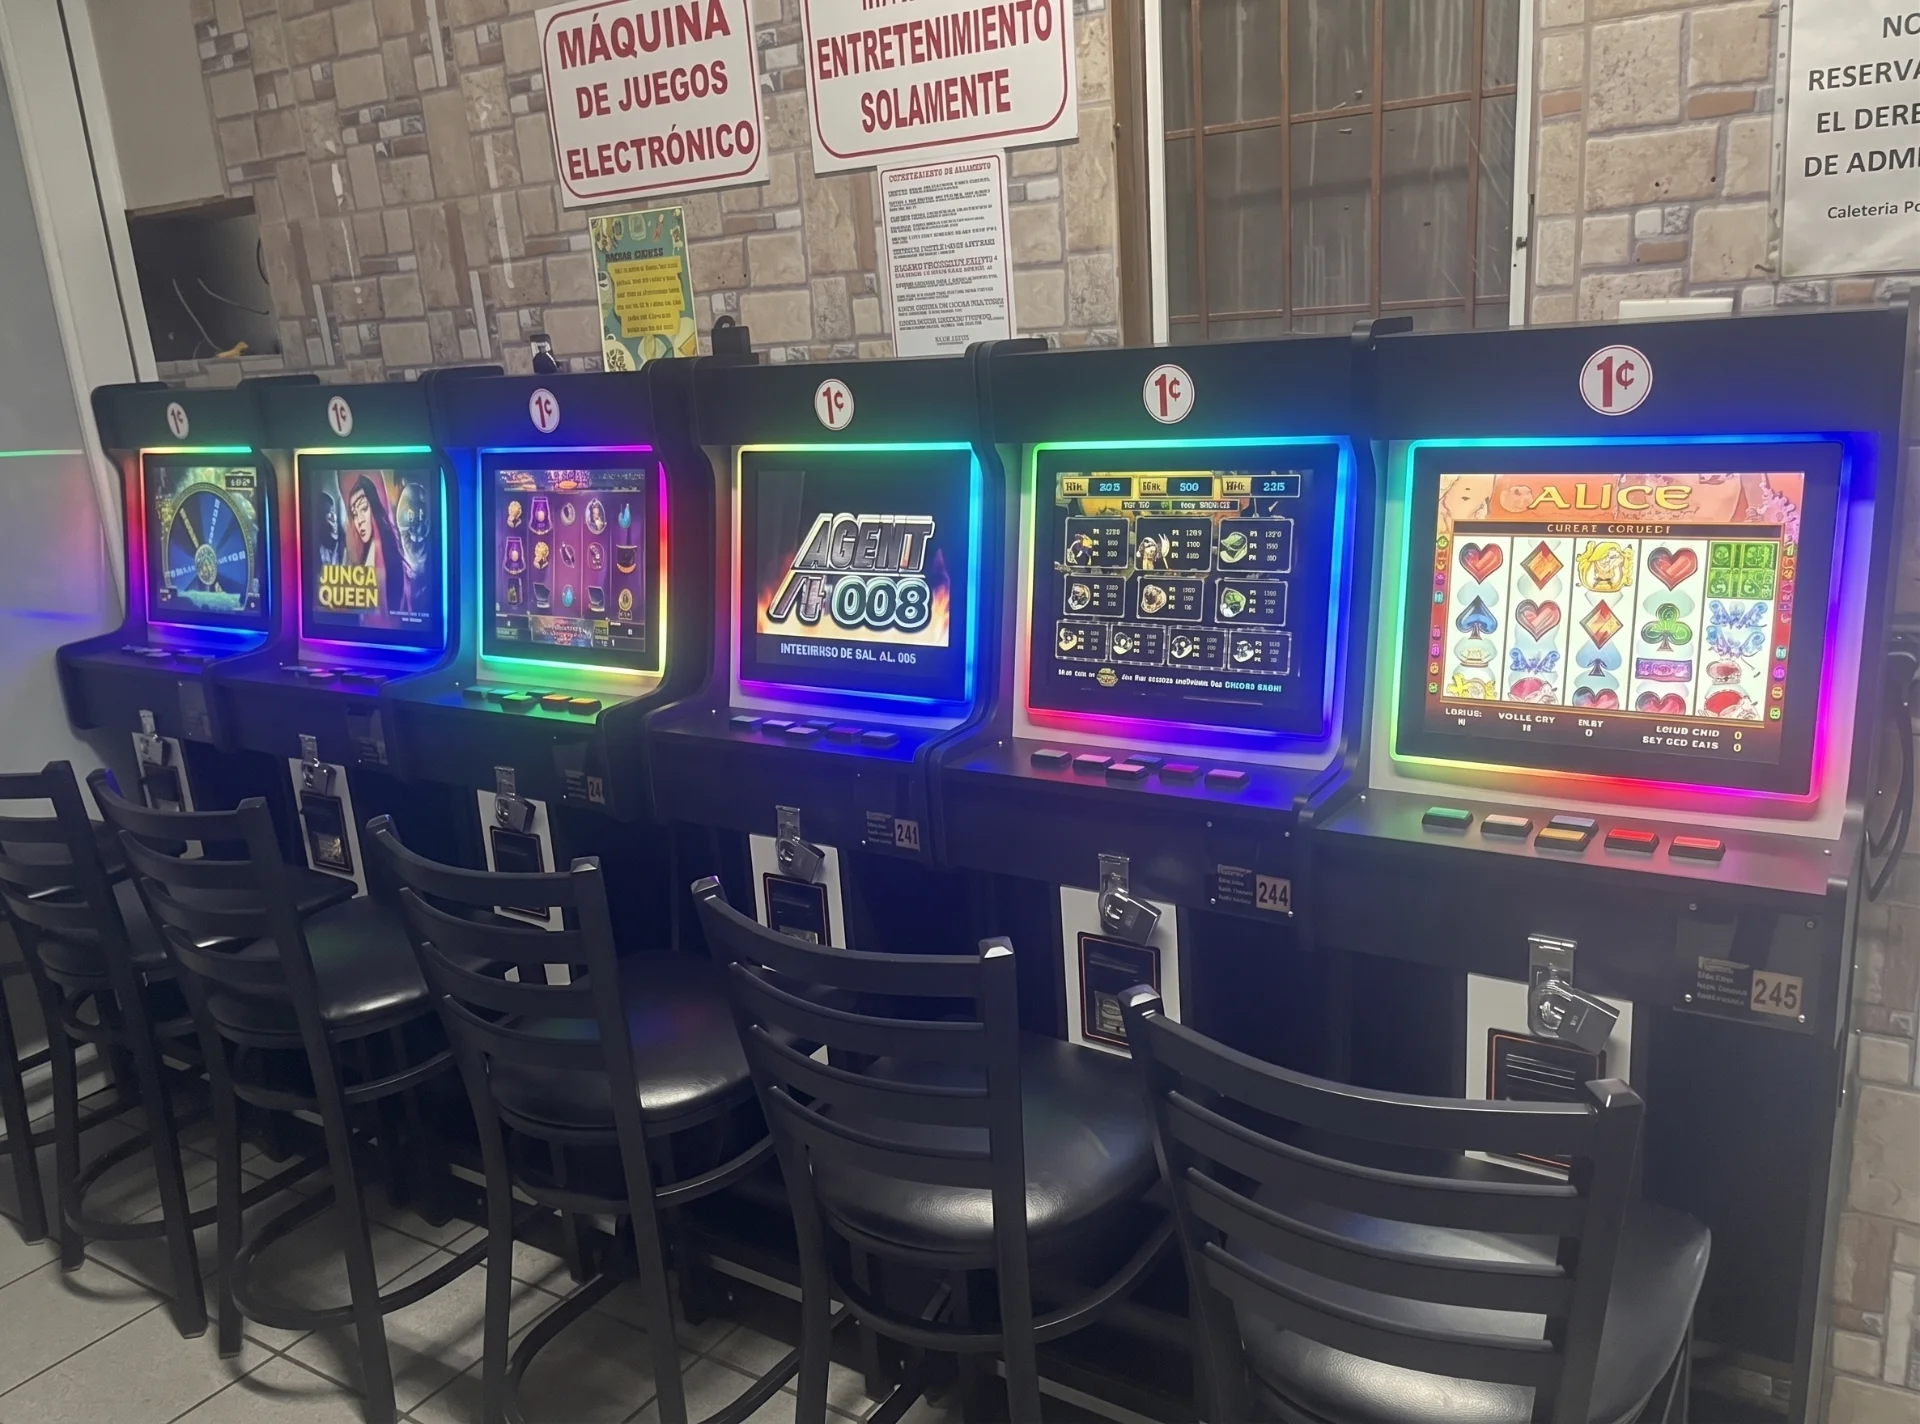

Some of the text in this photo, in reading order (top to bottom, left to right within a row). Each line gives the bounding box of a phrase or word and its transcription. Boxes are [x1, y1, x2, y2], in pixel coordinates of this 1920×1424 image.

[557, 0, 731, 70] MÁQUINA
[817, 0, 1052, 80] ENTRETENIMIENTO
[576, 60, 728, 119] DE JUEGOS
[861, 68, 1011, 133] SOLAMENTE
[1817, 111, 1845, 133] EL
[567, 120, 754, 180] ELECTRÓNICO
[1804, 154, 1838, 177] DE
[1155, 373, 1181, 416] 1¢
[1597, 355, 1635, 408] 1¢
[332, 403, 346, 432] 1¢
[535, 395, 552, 428] 1¢
[823, 387, 845, 424] 1¢
[1527, 483, 1692, 511] ALICE
[792, 513, 935, 572] AGENT
[319, 585, 378, 609] QUEEN
[832, 575, 931, 629] 008
[840, 648, 853, 659] DE
[897, 823, 918, 845] 241
[1258, 881, 1289, 907] 244
[1753, 978, 1798, 1010] 245
